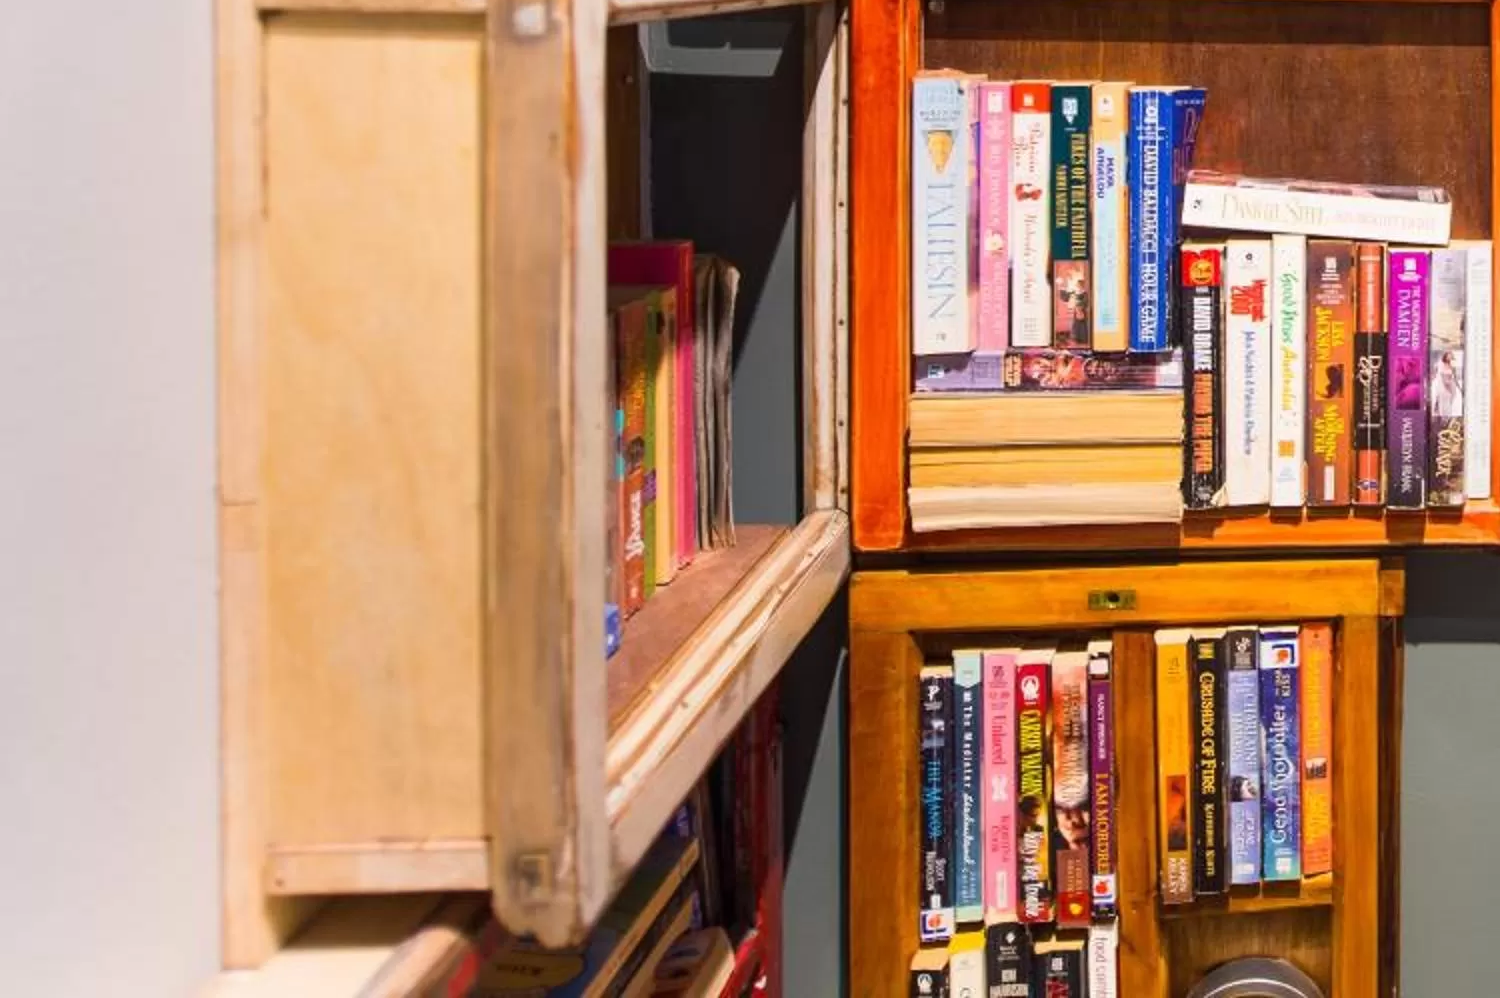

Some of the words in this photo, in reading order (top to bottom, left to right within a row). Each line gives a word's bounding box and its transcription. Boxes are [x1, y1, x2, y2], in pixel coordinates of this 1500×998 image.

[1071, 167, 1086, 183] OF
[1096, 146, 1106, 199] ANGELOU
[1105, 156, 1115, 188] MAYA
[1140, 144, 1157, 185] DAVID
[1071, 184, 1086, 206] THE
[1071, 207, 1086, 259] FAITHFUL
[1140, 188, 1157, 253] BALDACCI
[928, 182, 956, 320] TALIESIN
[1140, 263, 1157, 301] HOUR
[1140, 304, 1157, 344] GAME
[1193, 297, 1212, 331] DAVID
[1281, 308, 1298, 345] News
[1397, 289, 1412, 347] DAMIEN
[1193, 333, 1212, 371] DRAKE
[1243, 330, 1256, 347] John
[1315, 306, 1331, 362] JACKSON
[1330, 321, 1344, 347] LISA
[1193, 373, 1212, 415] PAYING
[1243, 388, 1255, 418] Patricia
[1193, 416, 1212, 437] THE
[1313, 417, 1327, 453] AFTER
[1325, 404, 1340, 462] MORNING
[1193, 438, 1212, 474] PIPER
[1401, 465, 1412, 493] FRANK
[963, 705, 974, 726] The
[1096, 693, 1105, 720] NANCY
[1200, 673, 1216, 737] CRUSADE
[991, 714, 1008, 766] Unlaced
[1019, 709, 1041, 751] CARRIE
[1201, 739, 1216, 757] OF
[1244, 693, 1258, 767] CHARLAINE
[928, 761, 941, 782] THE
[1020, 752, 1043, 797] VAUGHN
[1201, 759, 1217, 794] FIRE
[1096, 782, 1108, 805] AM
[924, 786, 944, 839] MANOR
[1272, 802, 1288, 843] Gena
[1096, 810, 1109, 874] MORDRE
[1023, 881, 1042, 917] Trouble
[1095, 936, 1107, 963] food
